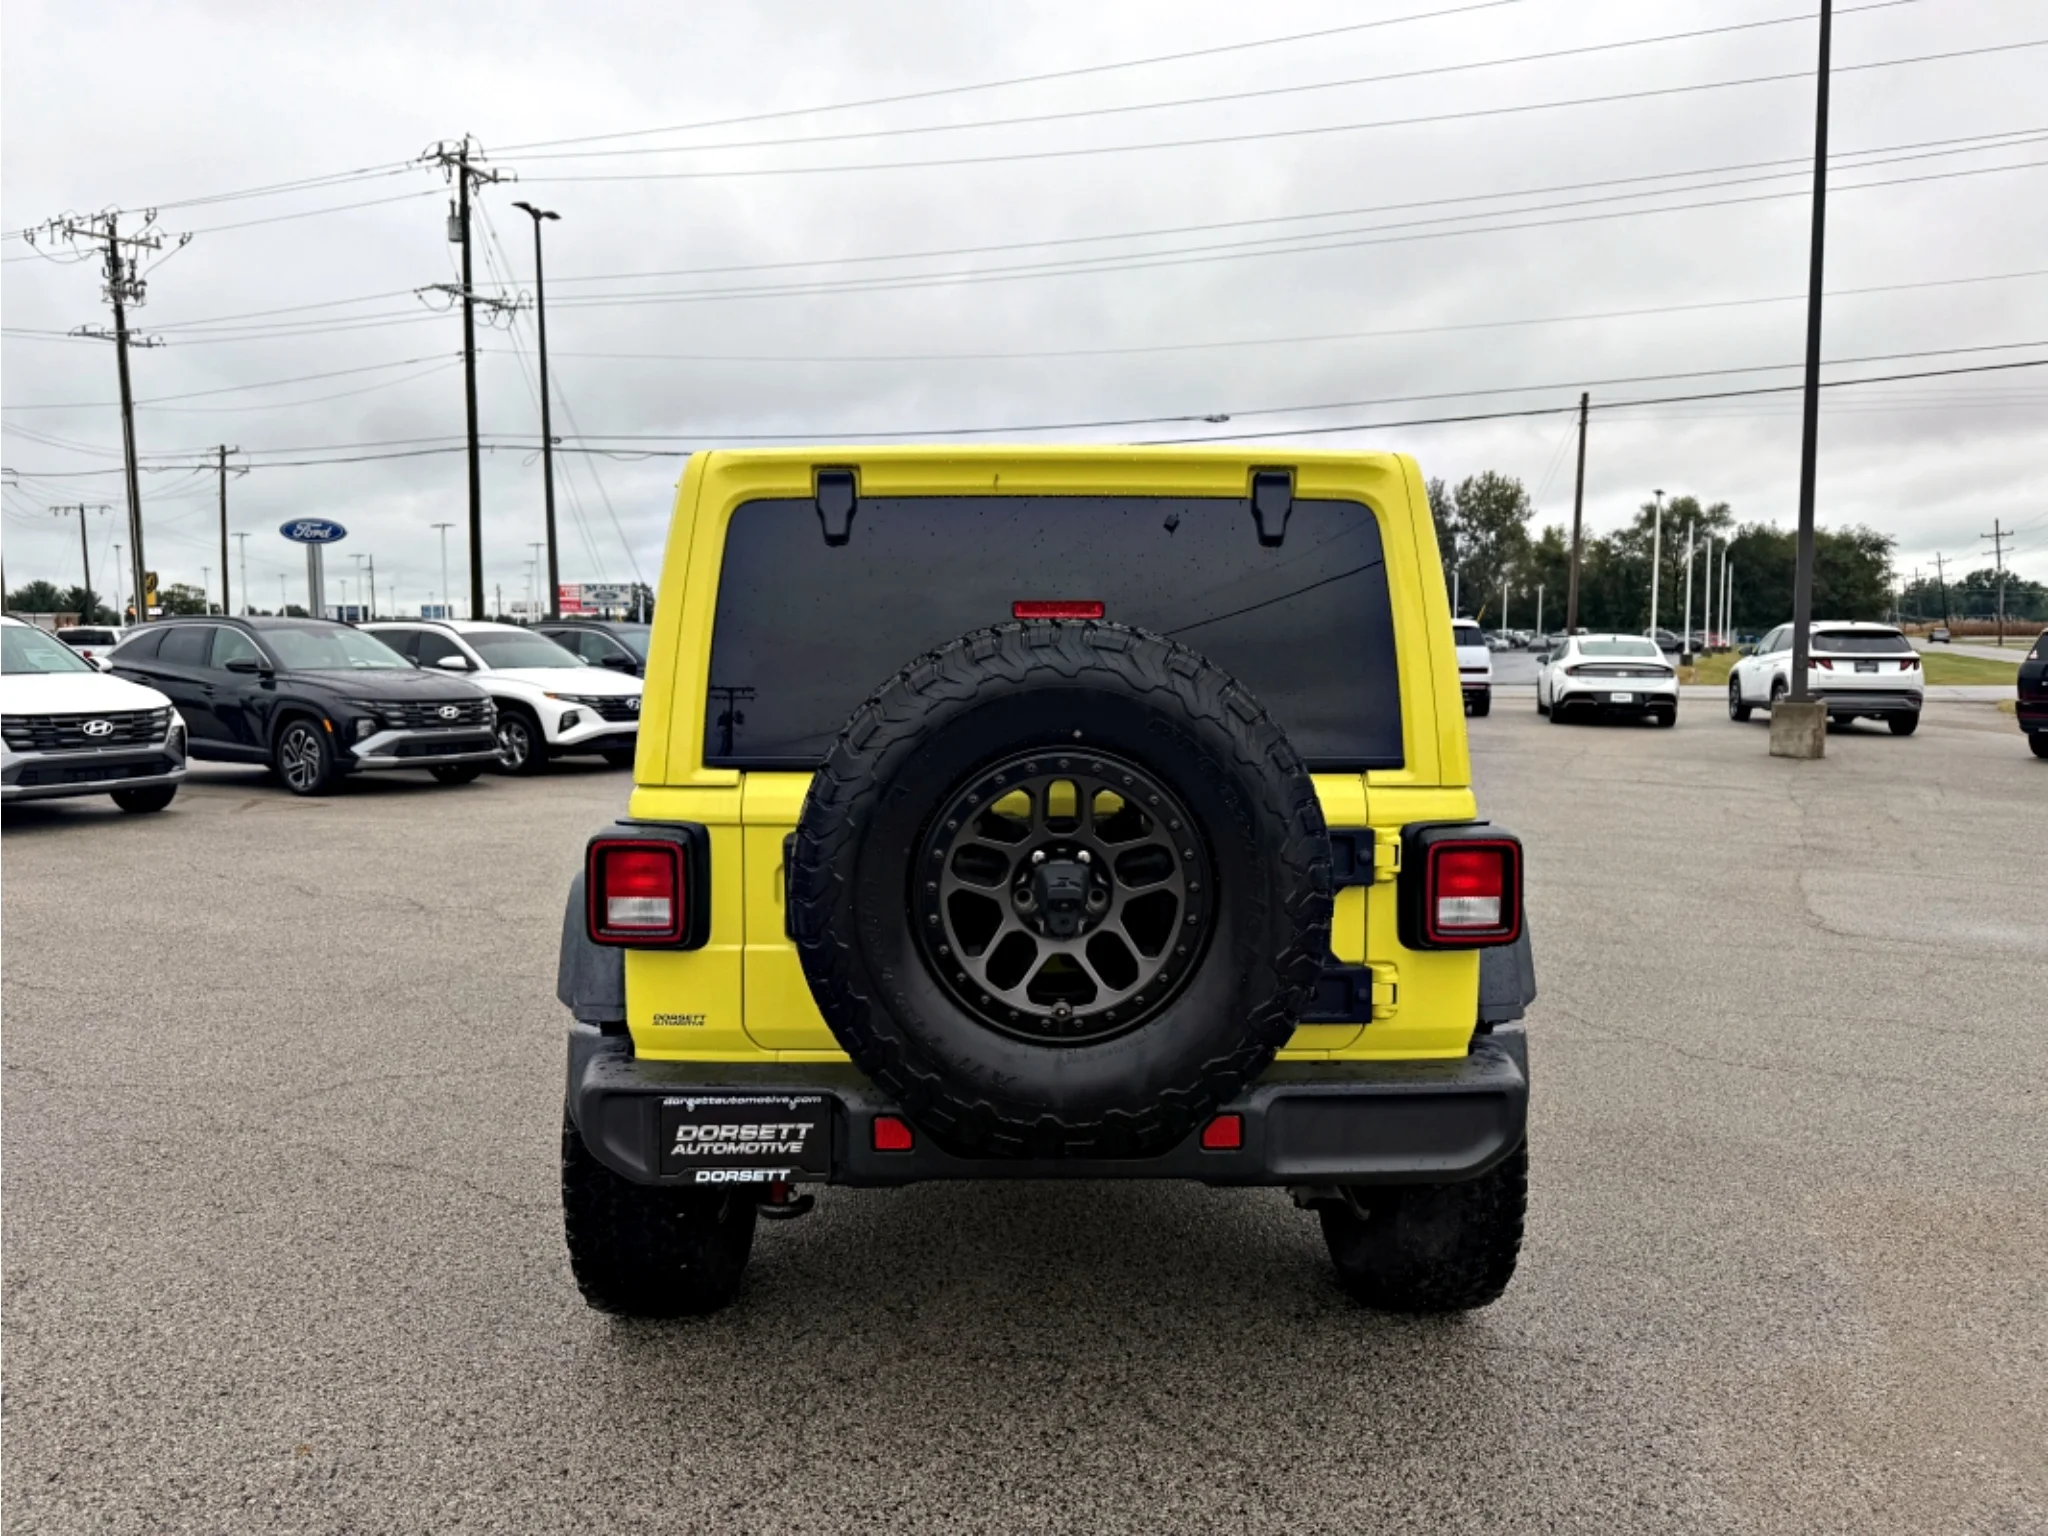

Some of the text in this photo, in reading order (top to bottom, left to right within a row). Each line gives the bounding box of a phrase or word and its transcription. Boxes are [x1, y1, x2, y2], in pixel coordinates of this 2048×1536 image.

[292, 522, 332, 538] Ford
[662, 1096, 822, 1105] dorsettautomotive.com
[676, 1123, 814, 1141] DORSETT
[671, 1142, 803, 1155] AUTOMOTIVE
[695, 1169, 791, 1183] DORSETT
